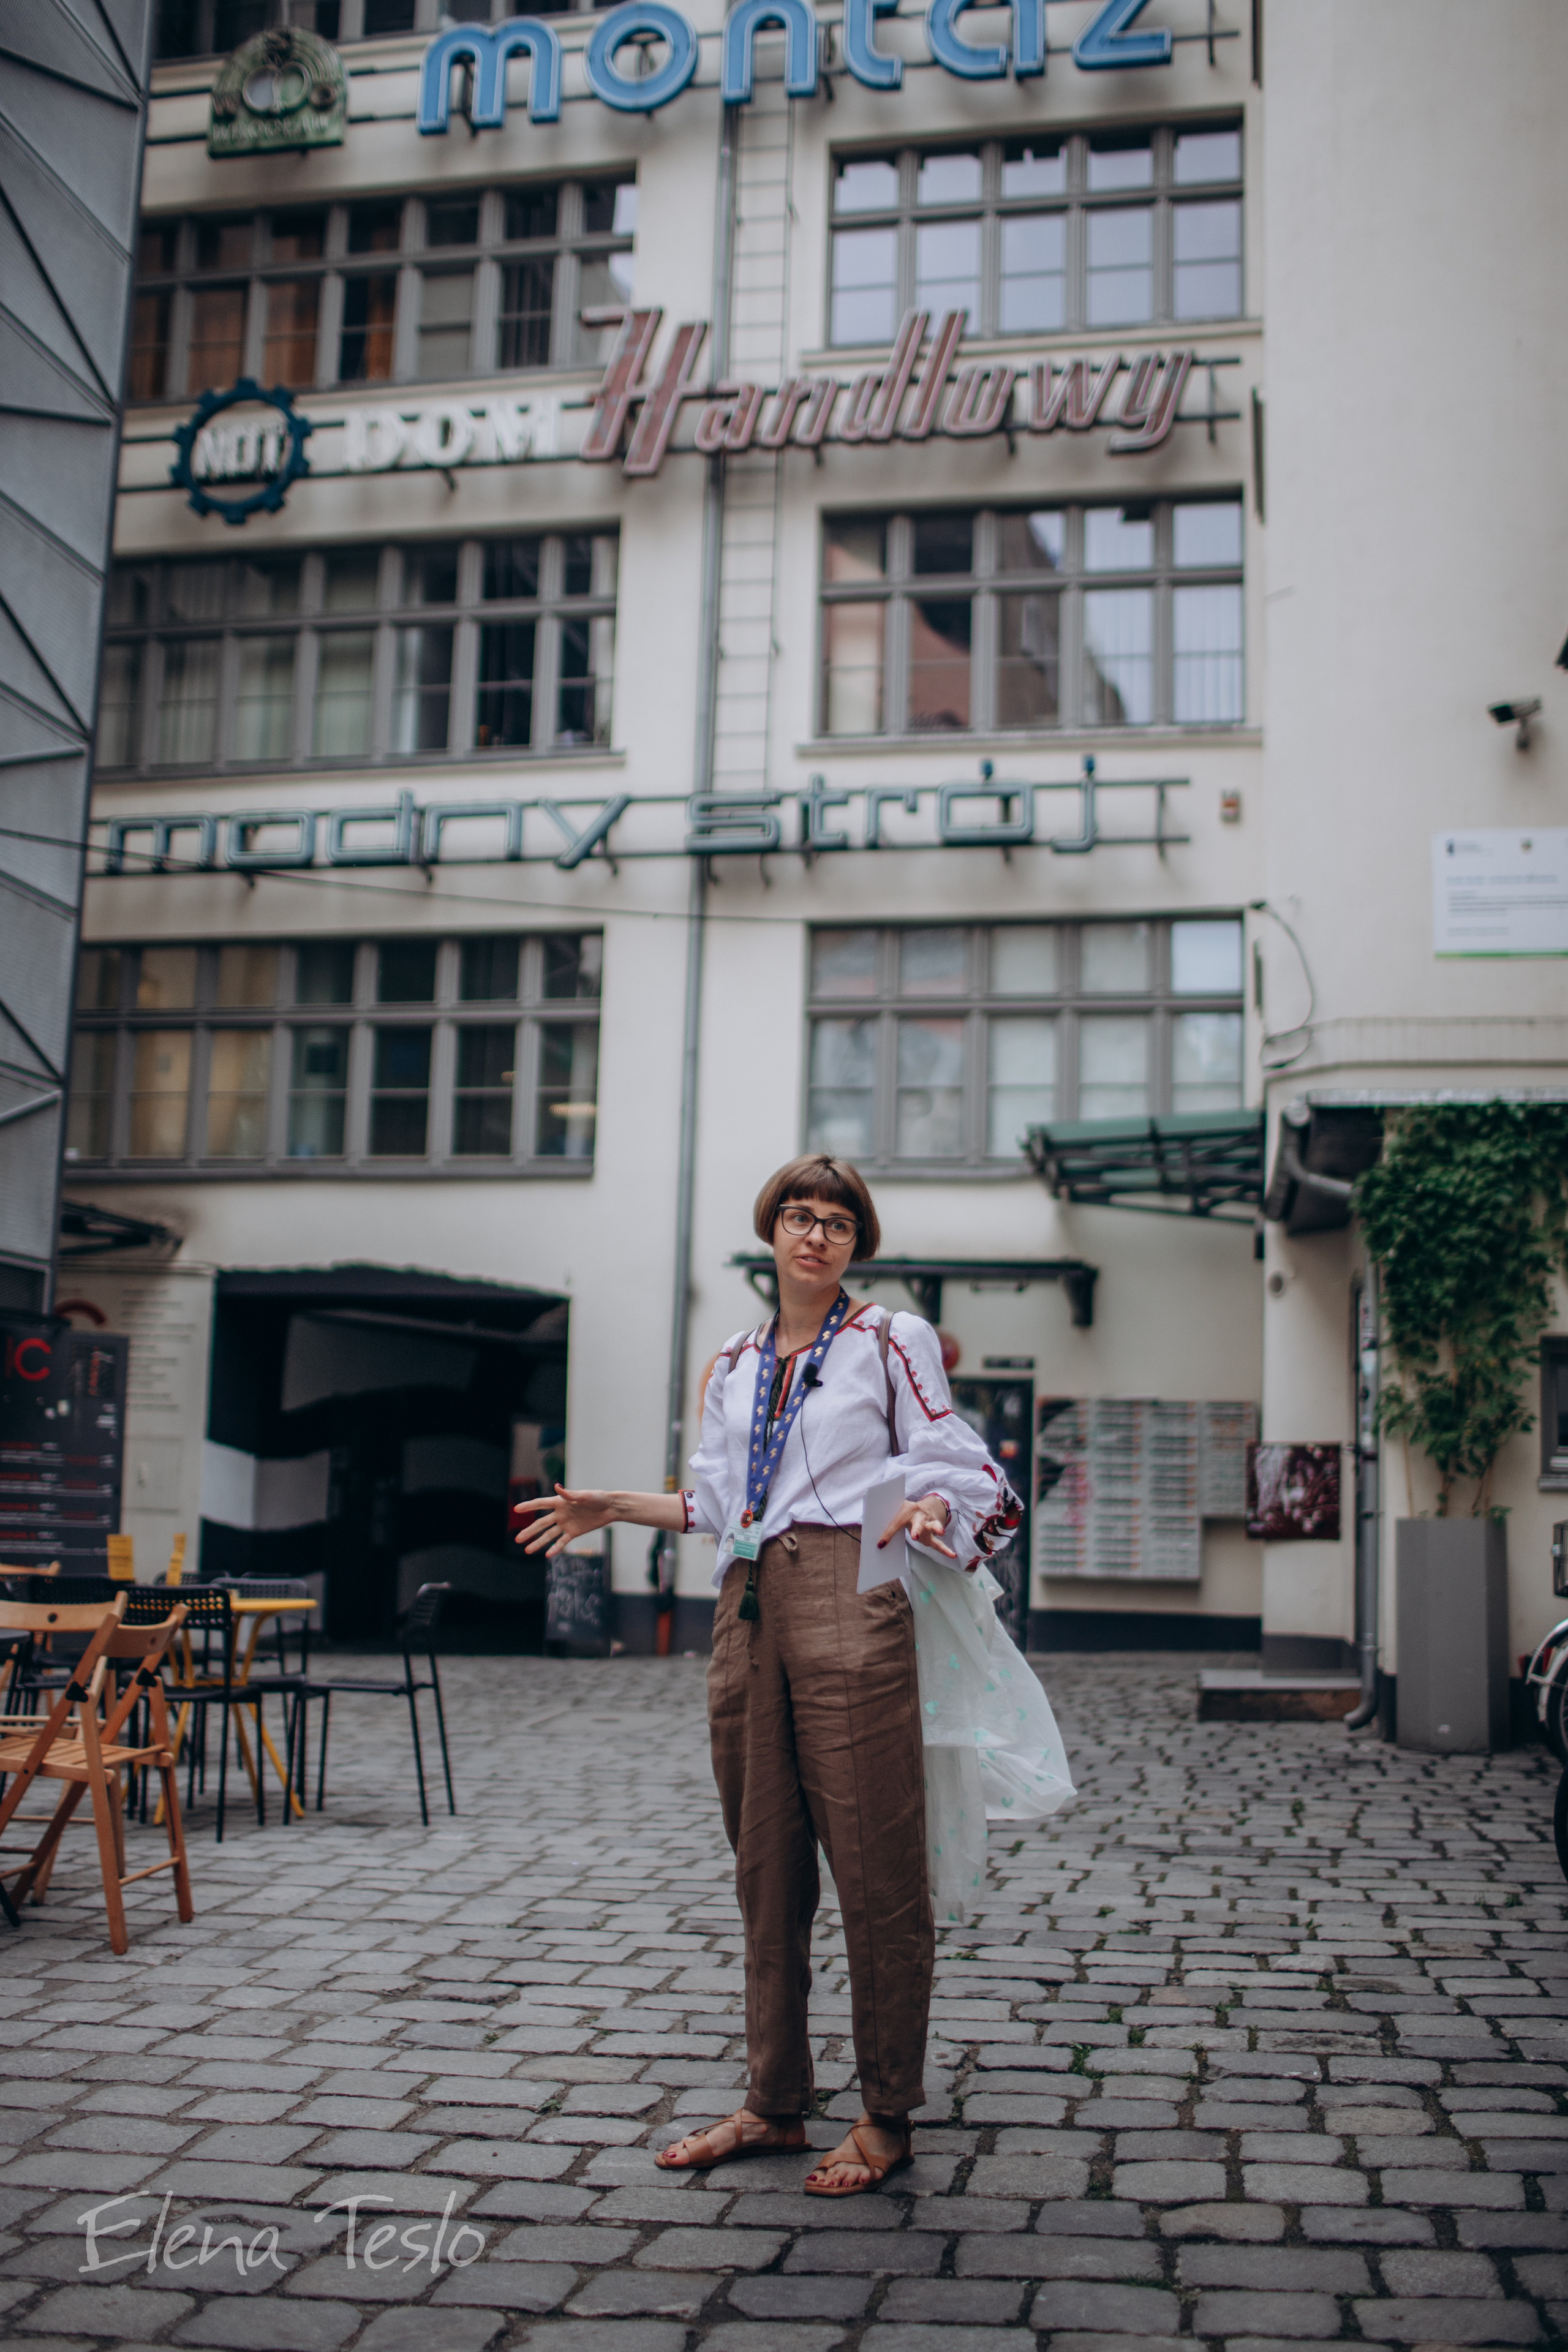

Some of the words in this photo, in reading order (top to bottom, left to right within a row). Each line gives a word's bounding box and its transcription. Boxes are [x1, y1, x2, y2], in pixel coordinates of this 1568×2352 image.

[344, 396, 560, 472] DOM
[579, 307, 1194, 476] Handlowy
[105, 788, 631, 874] modny
